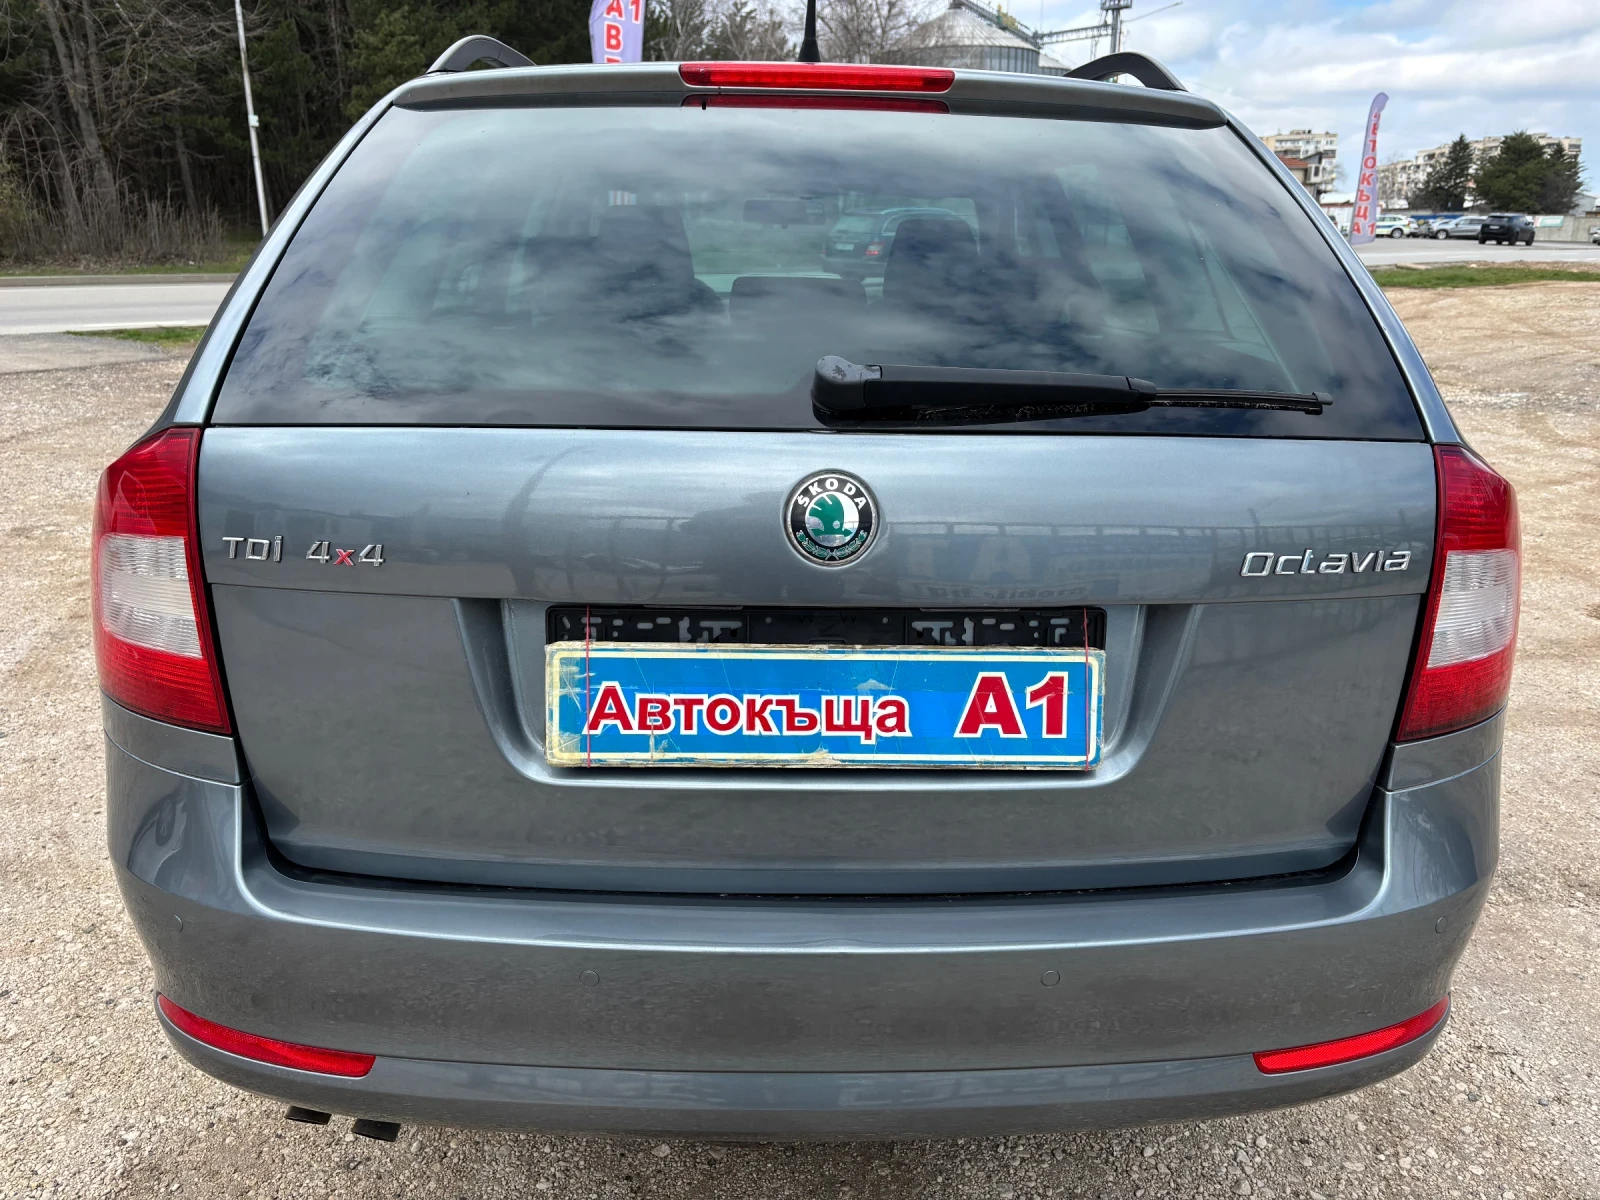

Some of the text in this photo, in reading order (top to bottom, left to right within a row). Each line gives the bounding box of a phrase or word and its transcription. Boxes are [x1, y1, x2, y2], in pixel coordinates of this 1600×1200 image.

[306, 540, 386, 567] 4x4
[1240, 548, 1412, 577] Octavia
[584, 681, 912, 745] Автокъща
